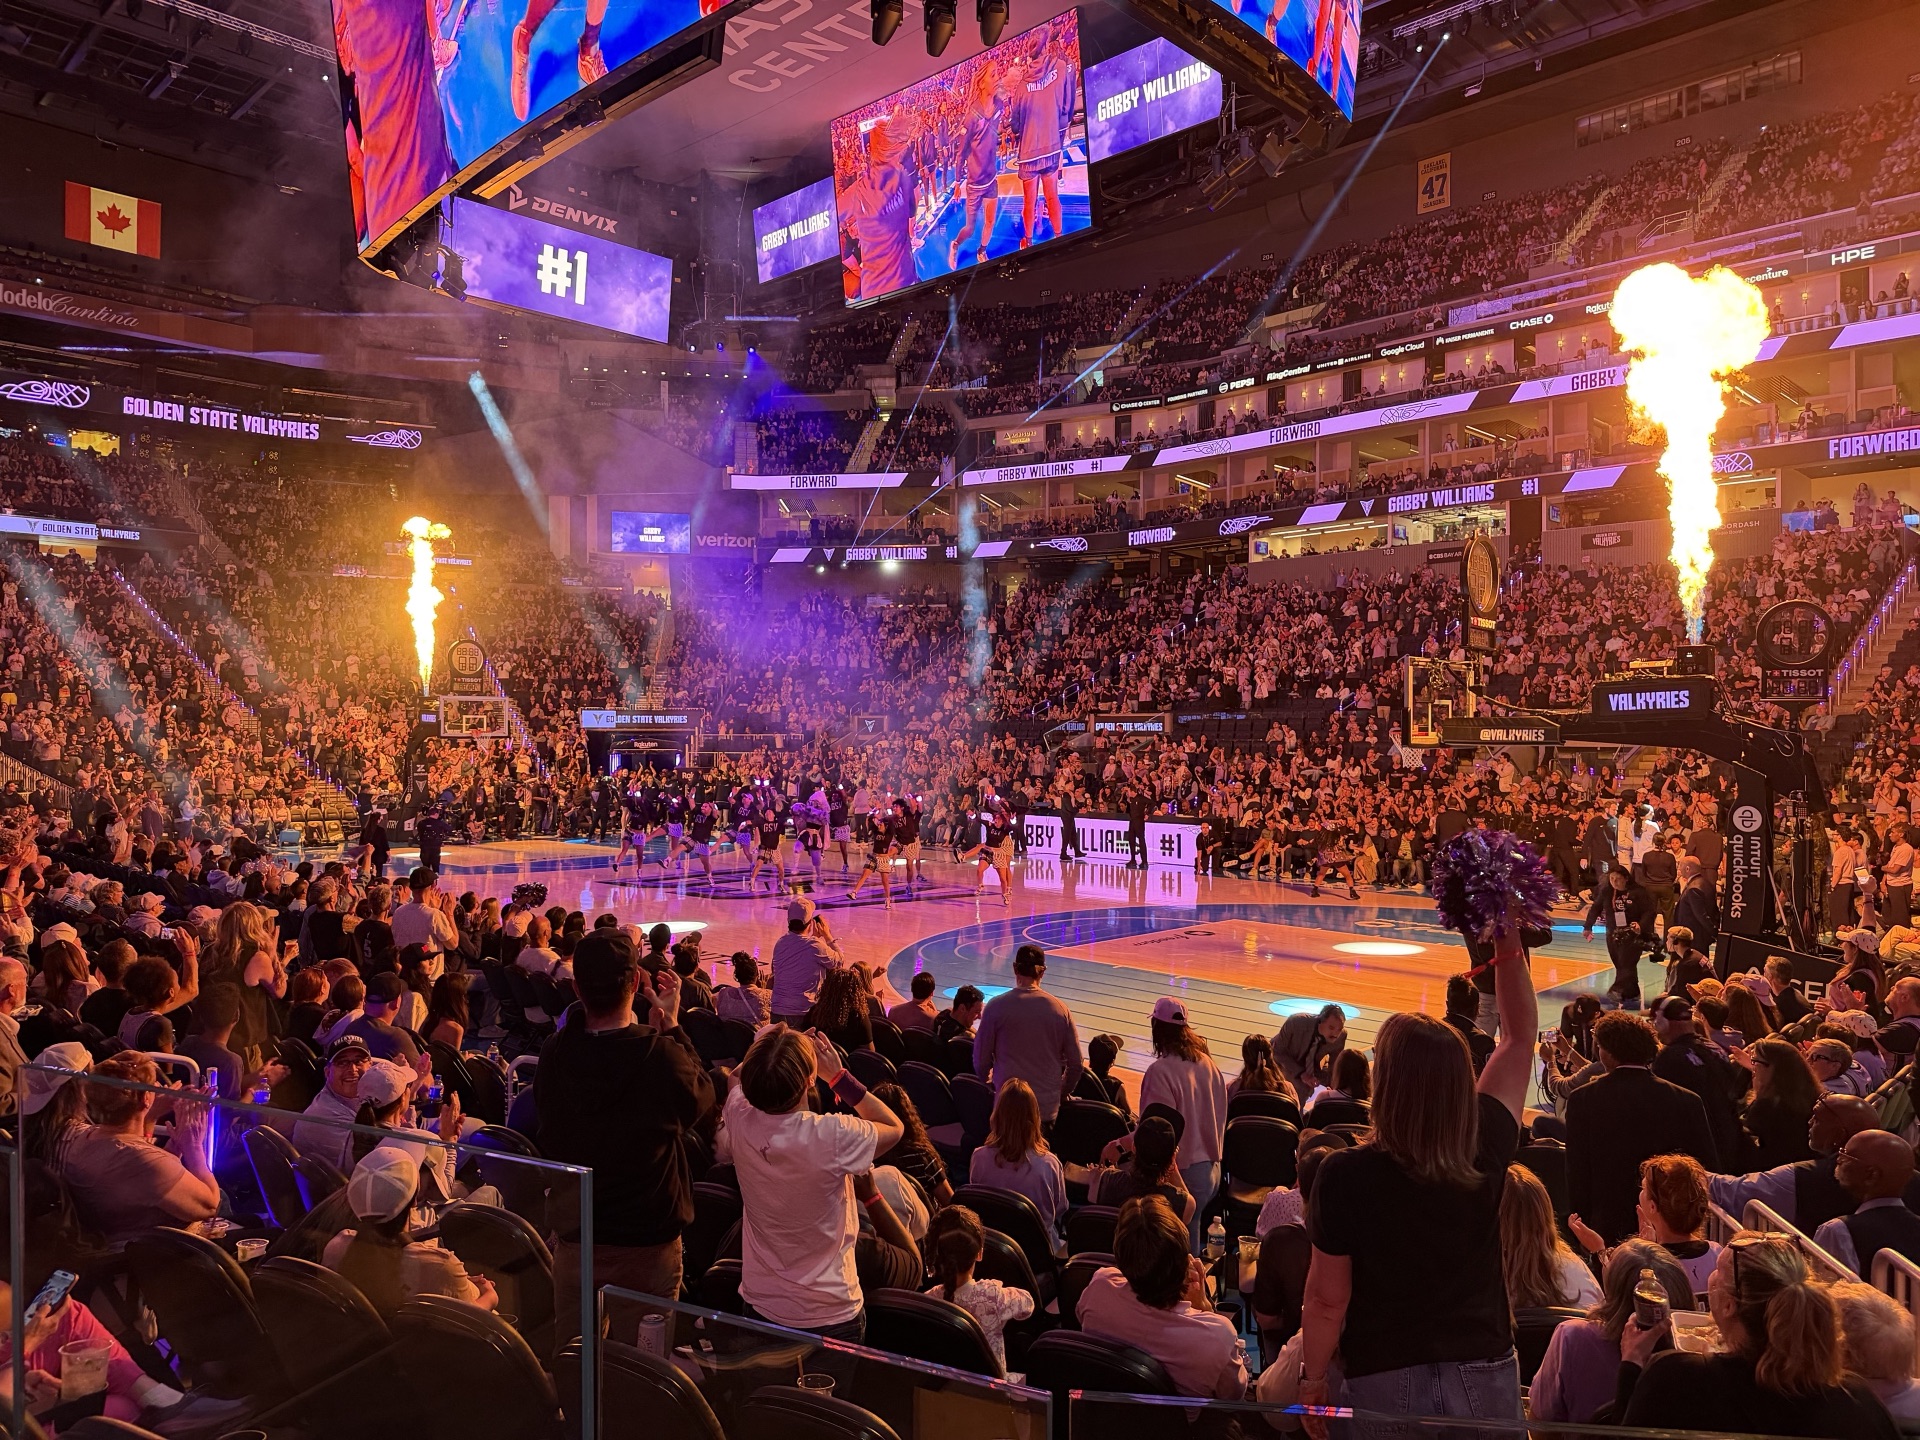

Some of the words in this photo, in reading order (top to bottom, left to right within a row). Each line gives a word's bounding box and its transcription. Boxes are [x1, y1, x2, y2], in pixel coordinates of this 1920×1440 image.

[1097, 87, 1140, 122] GABBY
[1143, 61, 1212, 103] WILLIAMS
[1421, 172, 1448, 199] 47
[1422, 198, 1446, 208] SEASONS
[1483, 192, 1496, 201] 205
[531, 196, 619, 234] DENVIX
[762, 227, 788, 252] GABBY
[789, 210, 830, 242] WILLIAMS
[1831, 246, 1876, 266] HPE
[536, 243, 589, 306] #1
[51, 293, 140, 327] Cantina
[1510, 316, 1543, 331] CHASE
[1380, 345, 1405, 357] Google
[1405, 341, 1425, 351] Cloud
[1316, 360, 1338, 369] UNITED
[1344, 353, 1372, 363] AIRLINES
[1266, 364, 1311, 381] RingCentral
[1571, 369, 1617, 392] GABBY
[1230, 377, 1255, 390] PEPSI
[123, 396, 184, 422] GOLDEN
[190, 407, 238, 430] STATE
[242, 414, 320, 440] VALKYRIES
[1269, 422, 1321, 443] FORWARD
[1829, 430, 1920, 460] FORWARD
[997, 467, 1027, 481] GABBY
[1029, 463, 1074, 477] WILLIAMS
[1091, 460, 1103, 471] #1
[790, 475, 837, 488] FORWARD
[1388, 492, 1428, 513] GABBY
[1431, 483, 1495, 507] WILLIAMS
[1521, 477, 1539, 495] #1
[42, 523, 72, 533] GOLDEN
[74, 526, 100, 536] STATE
[100, 528, 140, 540] VALKYRIES
[1720, 521, 1760, 529] OORDASH
[695, 533, 756, 548] verizon
[1128, 527, 1173, 546] FORWARD
[1592, 535, 1621, 547] VALKYRIES
[845, 547, 877, 561] GABBY
[879, 547, 928, 561] WILLIAMS
[945, 545, 958, 559] #1
[1478, 617, 1497, 630] TISSOT
[1781, 669, 1825, 677] TISSOT
[1608, 689, 1690, 712] VALKYRIES
[605, 715, 631, 723] GOLDEN
[632, 715, 653, 723] STATE
[654, 715, 688, 724] VALKYRIES
[1480, 728, 1545, 741] @VALKYRIES
[633, 741, 658, 749] Rakuten
[737, 806, 751, 816] GSV
[763, 822, 779, 833] GSV
[1025, 823, 1055, 848] BBY
[1160, 833, 1182, 859] #1
[1750, 835, 1761, 878] INTUIT
[1728, 833, 1749, 919] quickbooks
